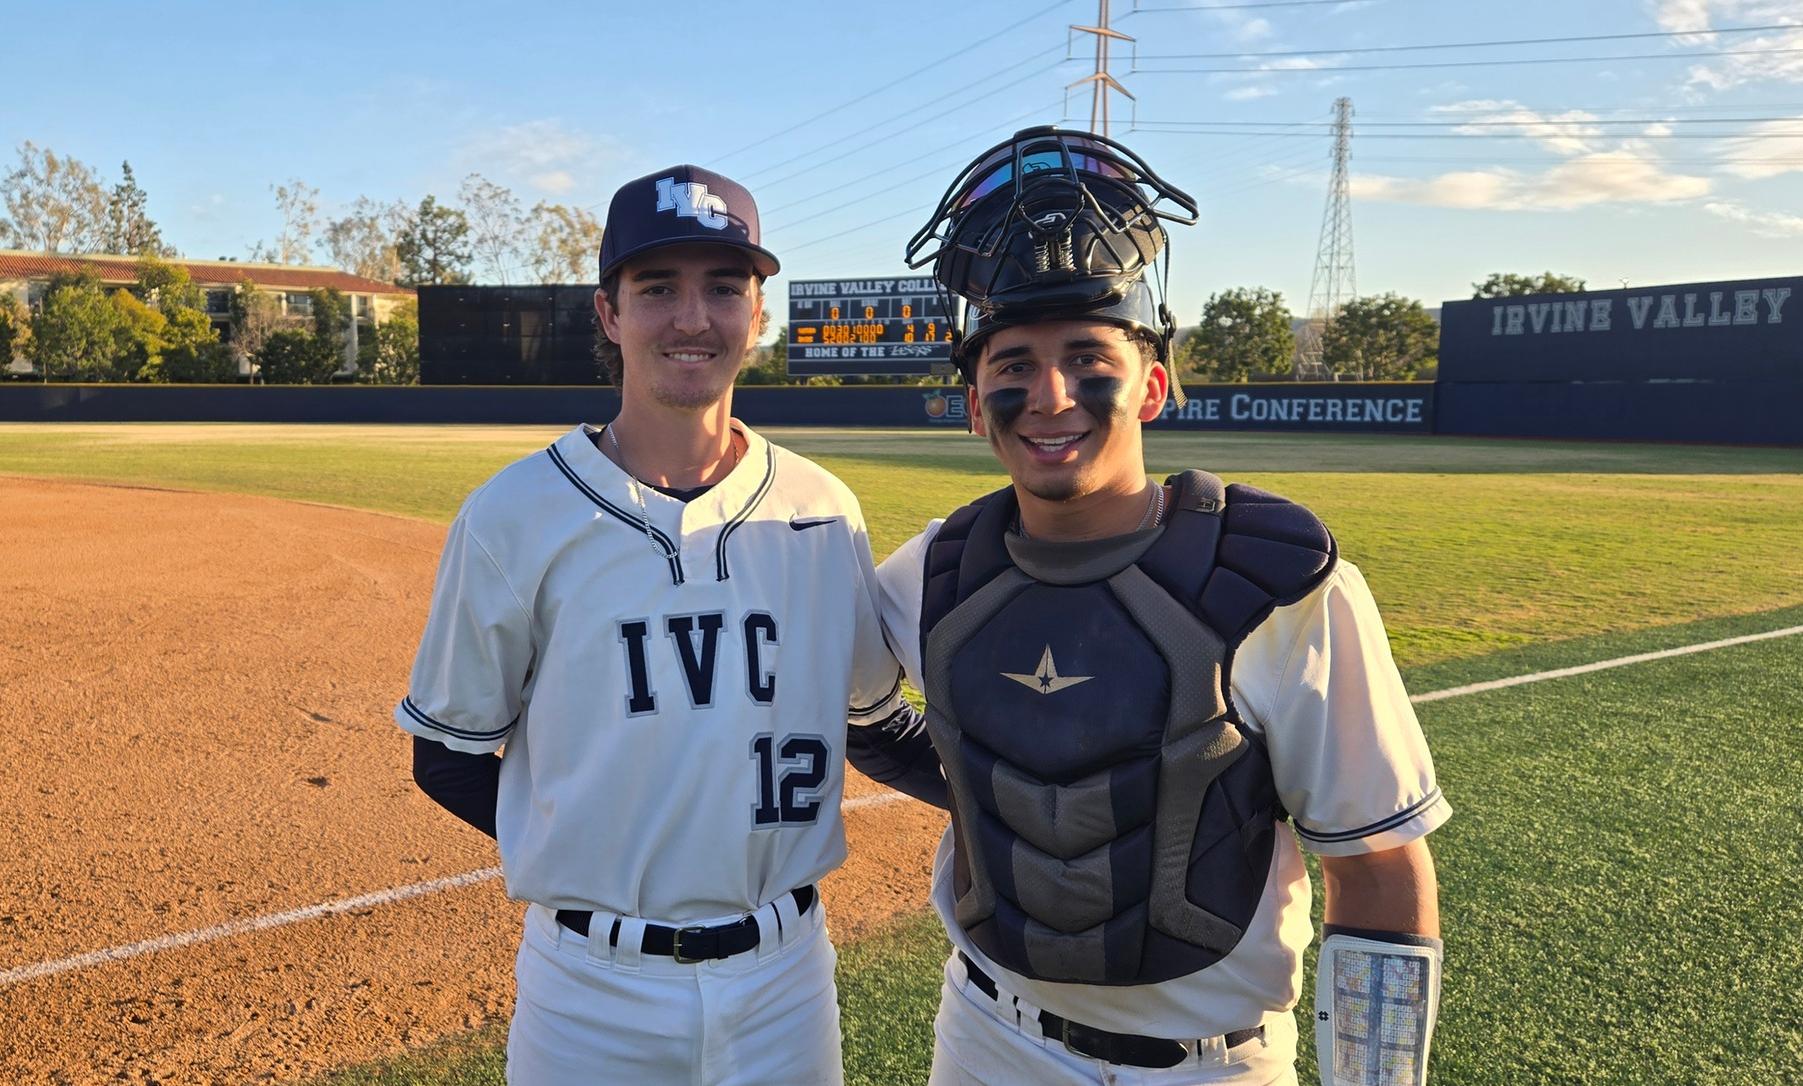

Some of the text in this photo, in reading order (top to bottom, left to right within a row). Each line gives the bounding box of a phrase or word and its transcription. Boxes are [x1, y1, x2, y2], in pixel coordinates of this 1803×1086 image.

[656, 177, 728, 230] IVC
[791, 279, 948, 295] IRVINE VALLEY COLL
[831, 306, 840, 320] 0
[865, 305, 874, 320] 0
[1491, 287, 1791, 336] IRVINE VALLEY
[805, 347, 839, 358] HOME
[842, 347, 856, 357] OF
[861, 346, 885, 357] THE
[1161, 398, 1220, 419] PIRE
[616, 609, 780, 718] IVC
[749, 731, 832, 831] 12
